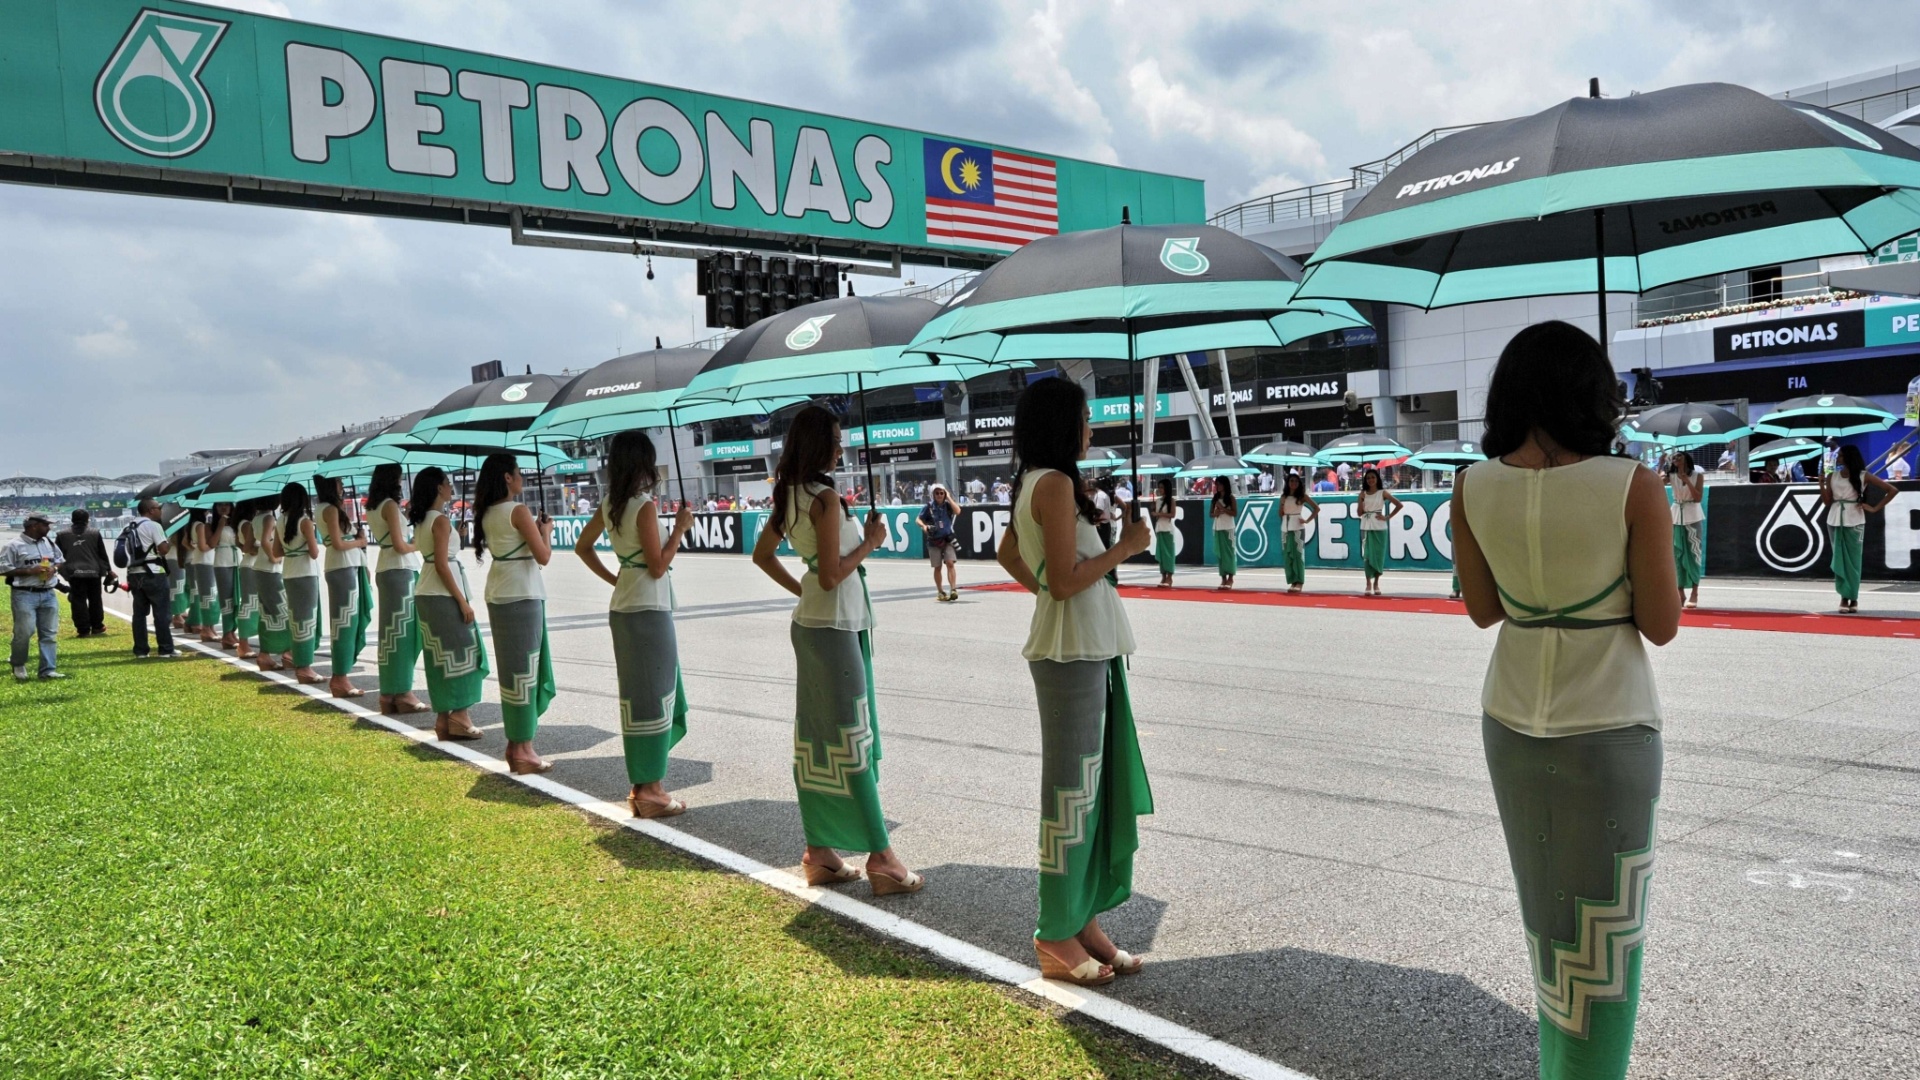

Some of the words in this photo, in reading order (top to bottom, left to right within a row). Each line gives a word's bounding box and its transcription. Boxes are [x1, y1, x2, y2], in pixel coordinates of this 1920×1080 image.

[285, 41, 895, 229] PETRONAS
[1395, 156, 1521, 199] PETRONAS
[1731, 322, 1838, 350] PETRONAS
[585, 381, 642, 397] PETRONAS
[1266, 381, 1338, 399] PETRONAS
[1788, 376, 1808, 389] FIA
[1213, 388, 1253, 406] PETONAS
[975, 416, 1015, 428] PETRON
[1284, 418, 1296, 428] FIA
[872, 427, 914, 439] PETRONAS
[716, 445, 749, 454] PETRONAS
